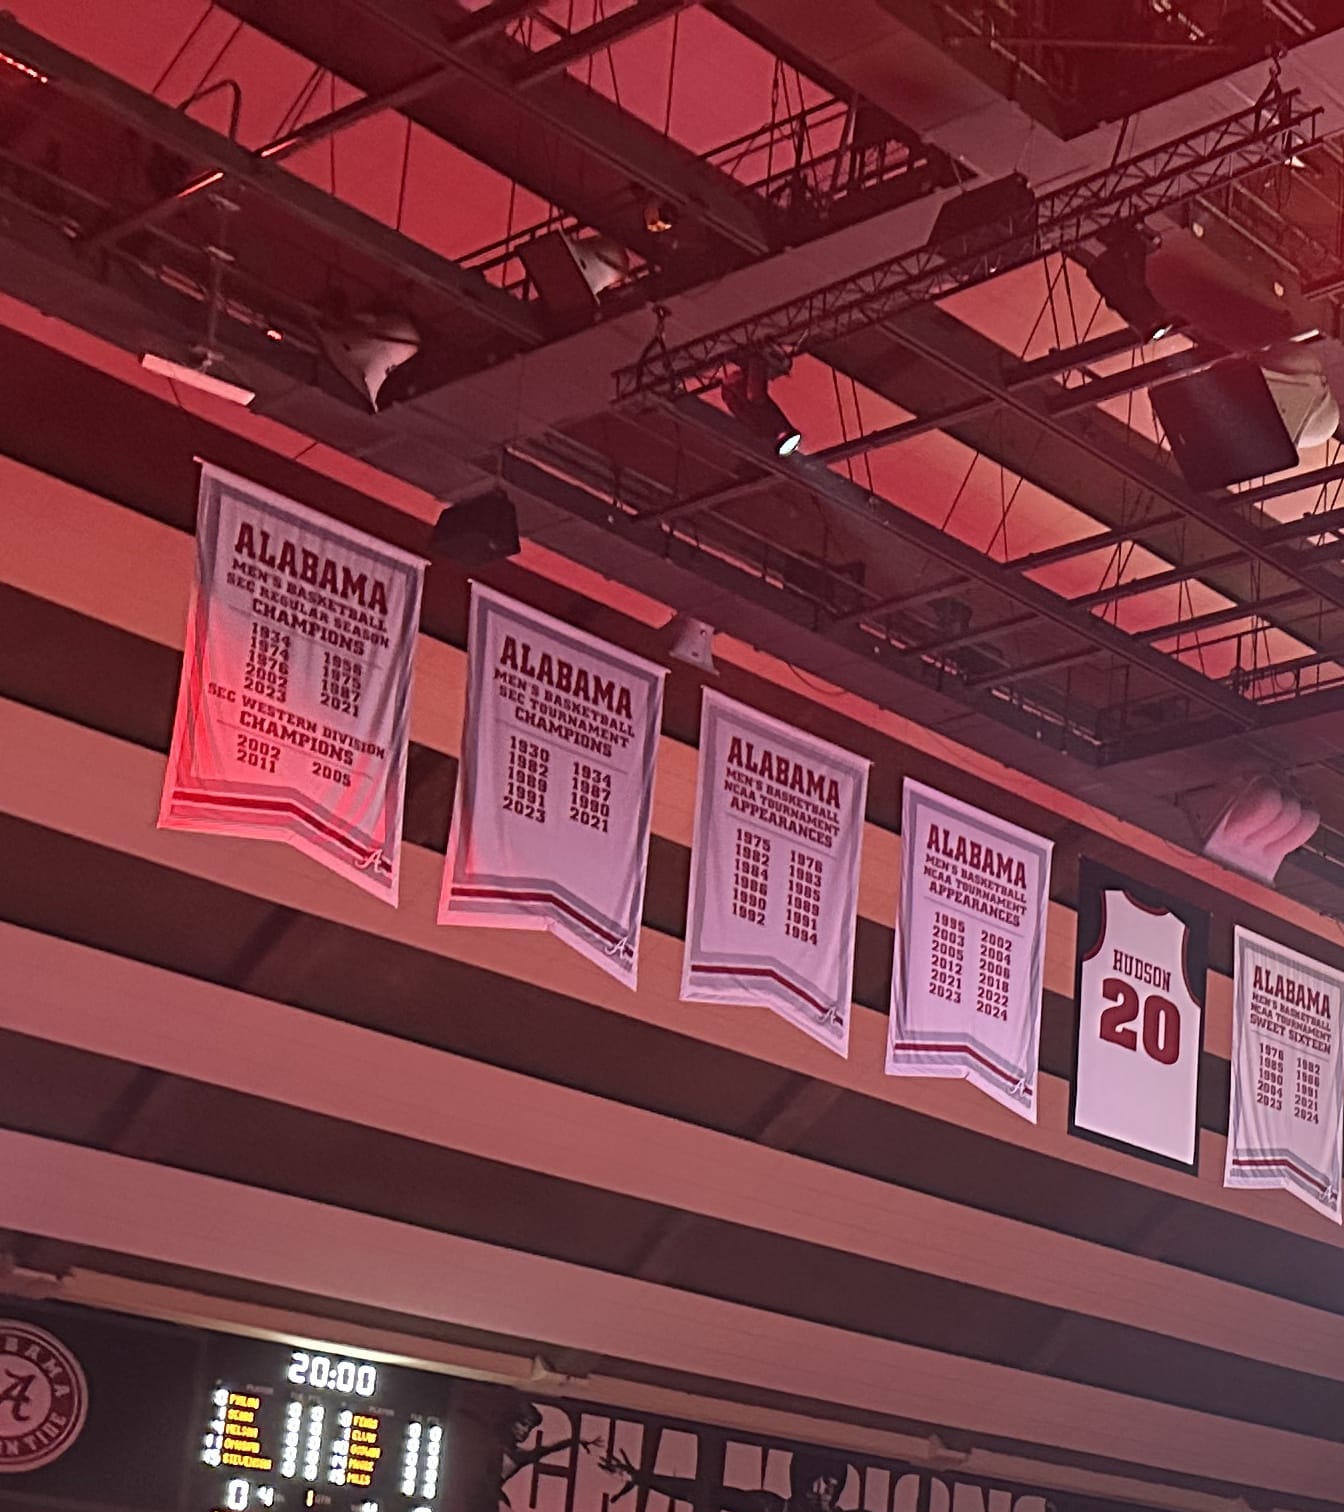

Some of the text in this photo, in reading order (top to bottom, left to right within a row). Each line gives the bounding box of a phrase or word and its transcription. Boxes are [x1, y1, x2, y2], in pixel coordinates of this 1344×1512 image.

[235, 521, 388, 615] ALABAMA
[227, 572, 389, 648] SEC REGULAR SEASON
[232, 558, 387, 632] MEN'S BASKETBALL
[252, 598, 364, 656] CHAMPIONS
[252, 622, 291, 648] 1934
[244, 677, 287, 703] 2023
[246, 663, 359, 717] 2002 2021
[500, 635, 632, 720] ALABAMA
[208, 682, 385, 759] SEC WESTERN DIVISION
[493, 668, 635, 738] MEN'S BASKETBALL
[500, 685, 629, 749] SEC TOURNAMENT
[237, 735, 280, 761] 2002
[240, 710, 353, 766] CHAMPIONS
[515, 706, 612, 758] CHAMPIONS
[237, 749, 276, 773] 2011
[509, 751, 611, 802] 1982 1987
[511, 736, 611, 788] 1930 1934
[728, 735, 841, 810] ALABAMA
[503, 796, 546, 823] 2023
[508, 782, 608, 833] 1991 2021
[724, 780, 840, 836] NCAA TOURNAMENT
[726, 767, 840, 825] MEN'S BASKETBALL
[730, 796, 832, 849] APPEARANCES
[736, 828, 771, 852] 1975
[926, 823, 1027, 889] ALABAMA
[926, 854, 1027, 904] MEN'S BASKETBALL
[924, 866, 1027, 915] NCAA TOURNAMENT
[929, 881, 1020, 927] APPEARANCES
[786, 909, 817, 931] 1991
[981, 930, 1012, 951] 2002
[931, 955, 963, 976] 2012
[932, 940, 964, 962] 2005
[933, 926, 1011, 966] 2003 2004
[1112, 949, 1171, 993] HUDSON
[929, 982, 1008, 1022] 2023 2024
[931, 969, 1009, 1008] 2021 2022
[1253, 965, 1331, 1018] ALABAMA
[1099, 977, 1180, 1065] 20
[1250, 1014, 1332, 1055] SWEET SIXTEEN
[1275, 1011, 1332, 1043] TOURNAMENT
[288, 1352, 377, 1397] 20:00
[227, 1478, 249, 1511] 0
